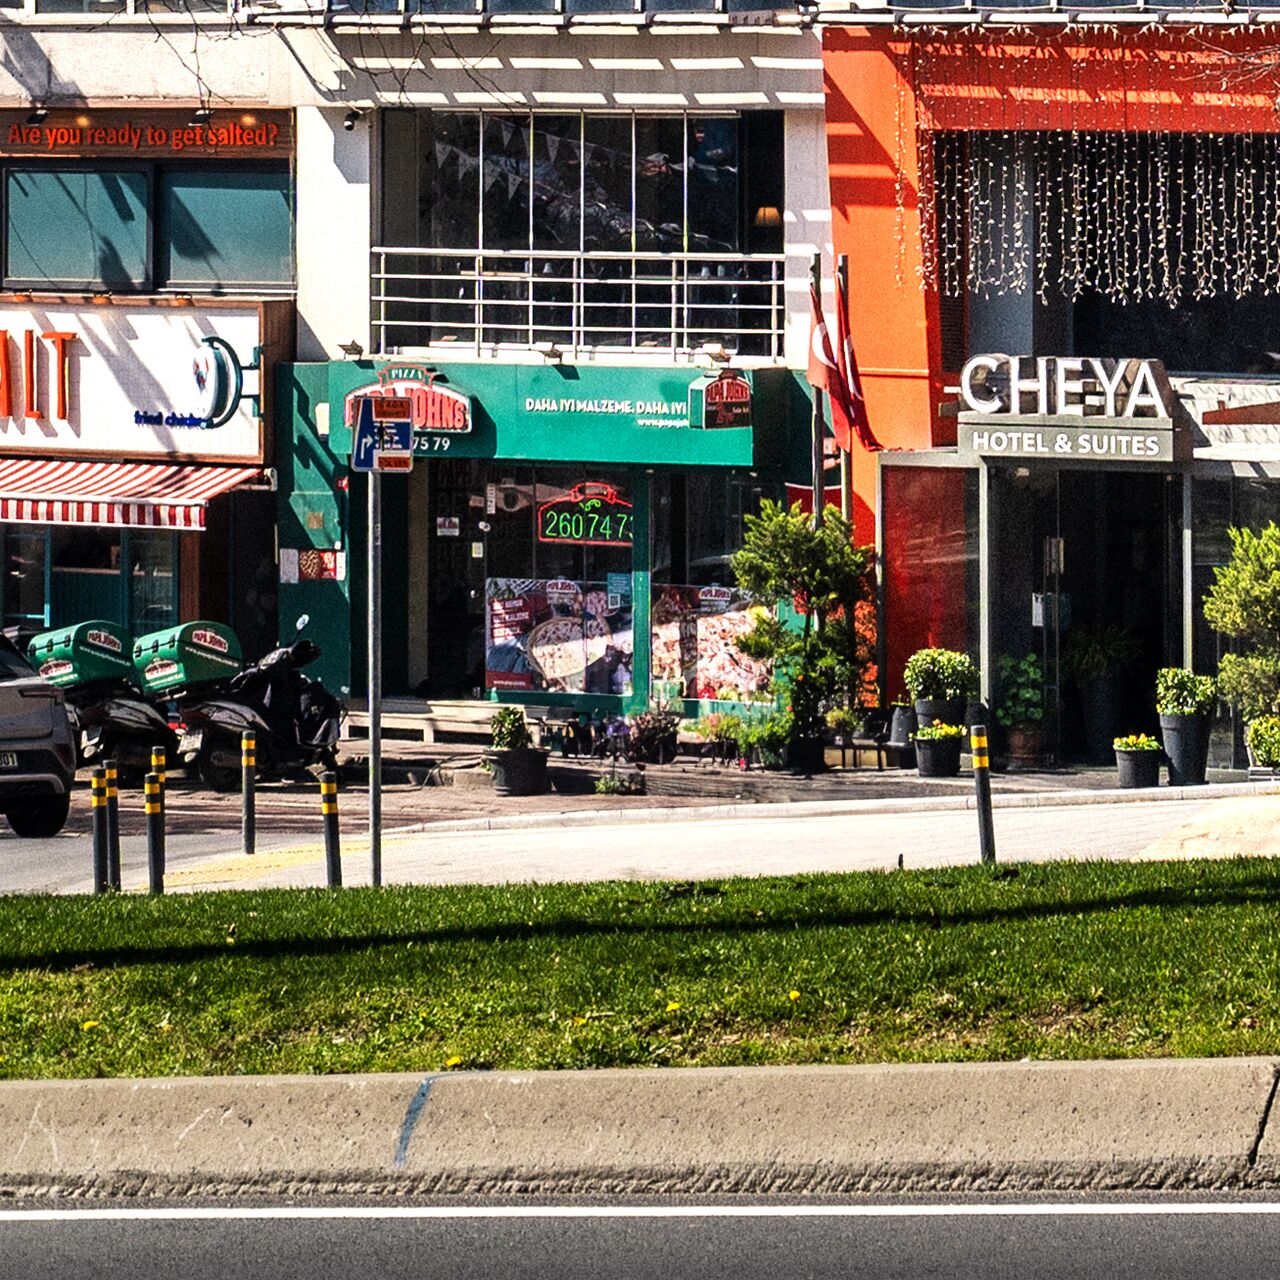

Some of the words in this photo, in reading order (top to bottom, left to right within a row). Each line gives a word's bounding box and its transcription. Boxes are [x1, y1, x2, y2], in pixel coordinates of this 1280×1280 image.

[9, 124, 40, 145] Are
[46, 127, 81, 149] you
[87, 122, 141, 150] ready
[148, 123, 166, 145] to
[172, 126, 203, 150] get
[208, 123, 279, 146] salted?
[960, 355, 1169, 419] CHEYA
[525, 398, 558, 413] DAHA
[636, 401, 669, 415] DAHA
[433, 437, 451, 451] 79
[972, 431, 1049, 453] HOTEL
[1054, 433, 1072, 454] &
[1077, 434, 1160, 456] SUITES
